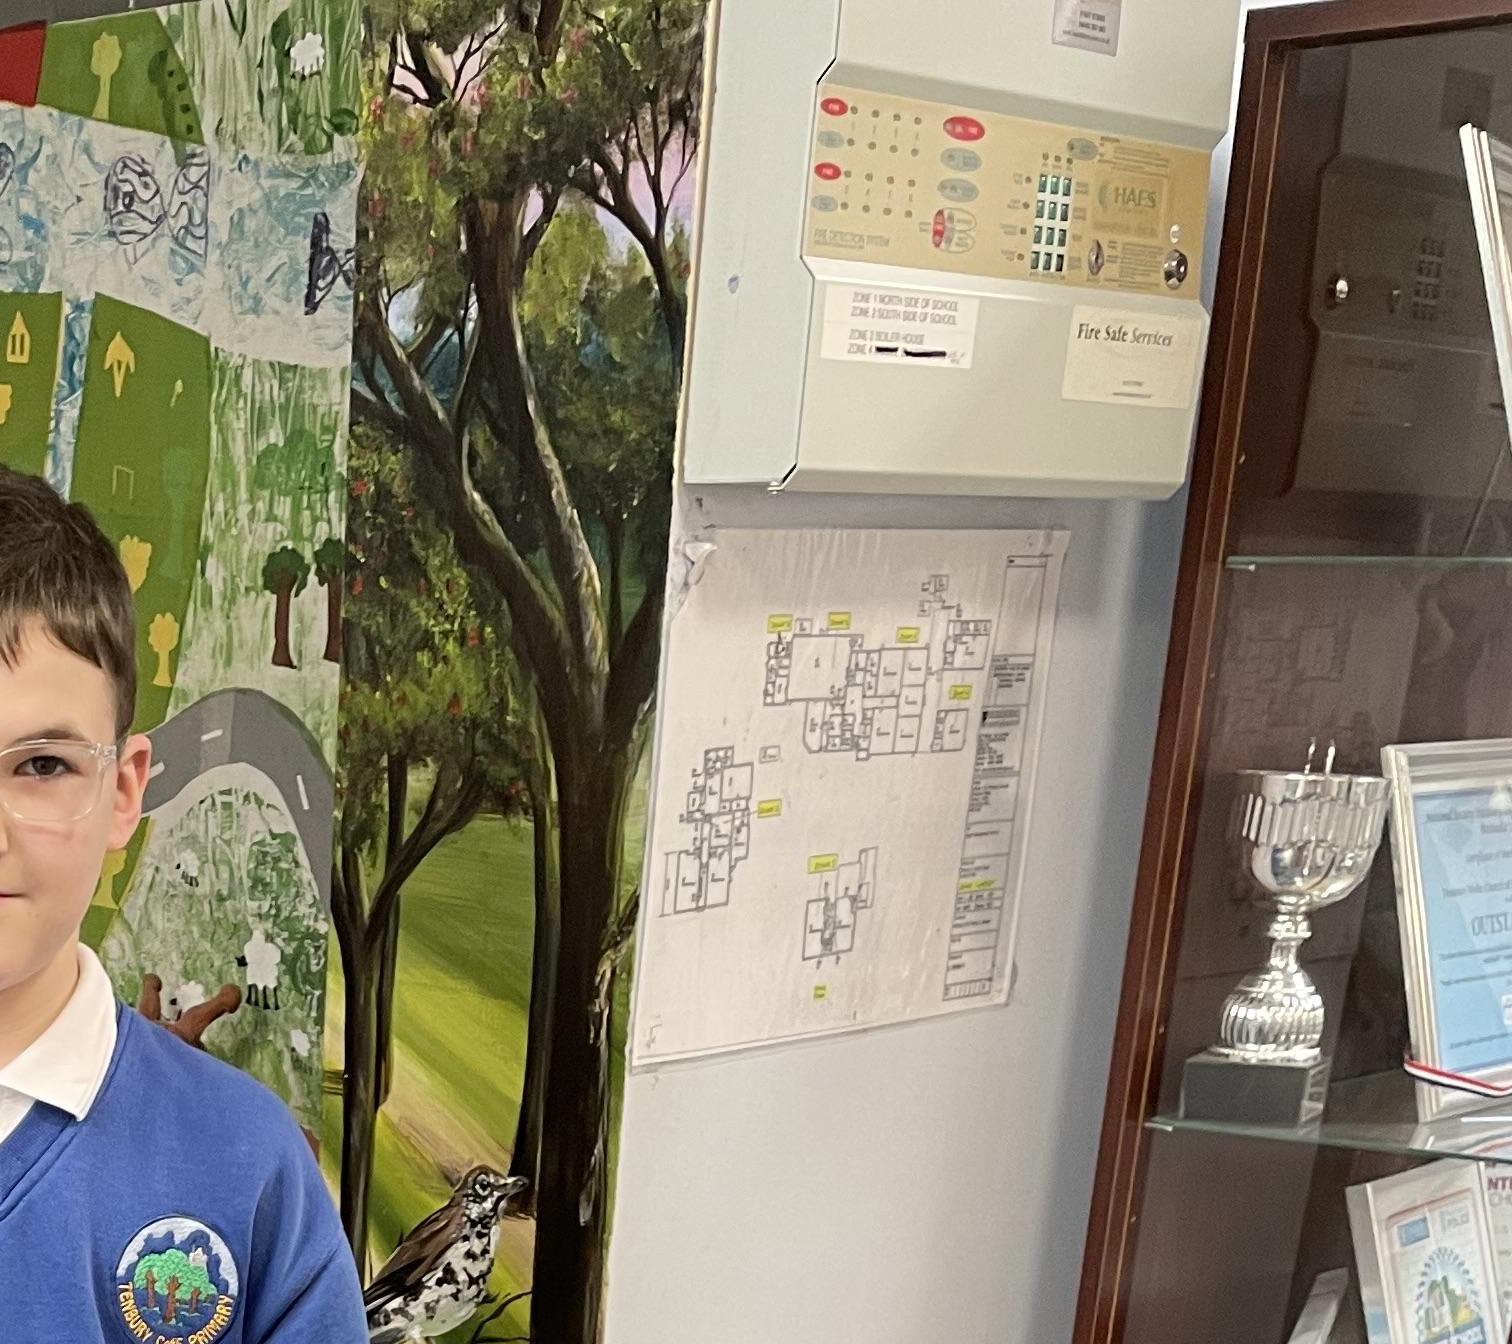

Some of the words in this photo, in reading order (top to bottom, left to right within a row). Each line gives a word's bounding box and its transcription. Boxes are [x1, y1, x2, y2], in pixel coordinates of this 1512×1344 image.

[853, 292, 871, 303] ZONE
[904, 296, 920, 308] SIDE
[921, 298, 930, 308] OF
[932, 299, 959, 312] SCHOOL
[851, 306, 869, 317] ZONE
[902, 310, 918, 322] SIDE
[919, 311, 929, 323] OF
[930, 312, 957, 325] SCHOOL
[849, 329, 868, 340] ZONE
[1077, 323, 1101, 340] Fire
[1103, 325, 1128, 342] Safe
[1129, 328, 1173, 346] Services
[848, 343, 866, 354] ZONE
[1471, 912, 1512, 937] OUTST
